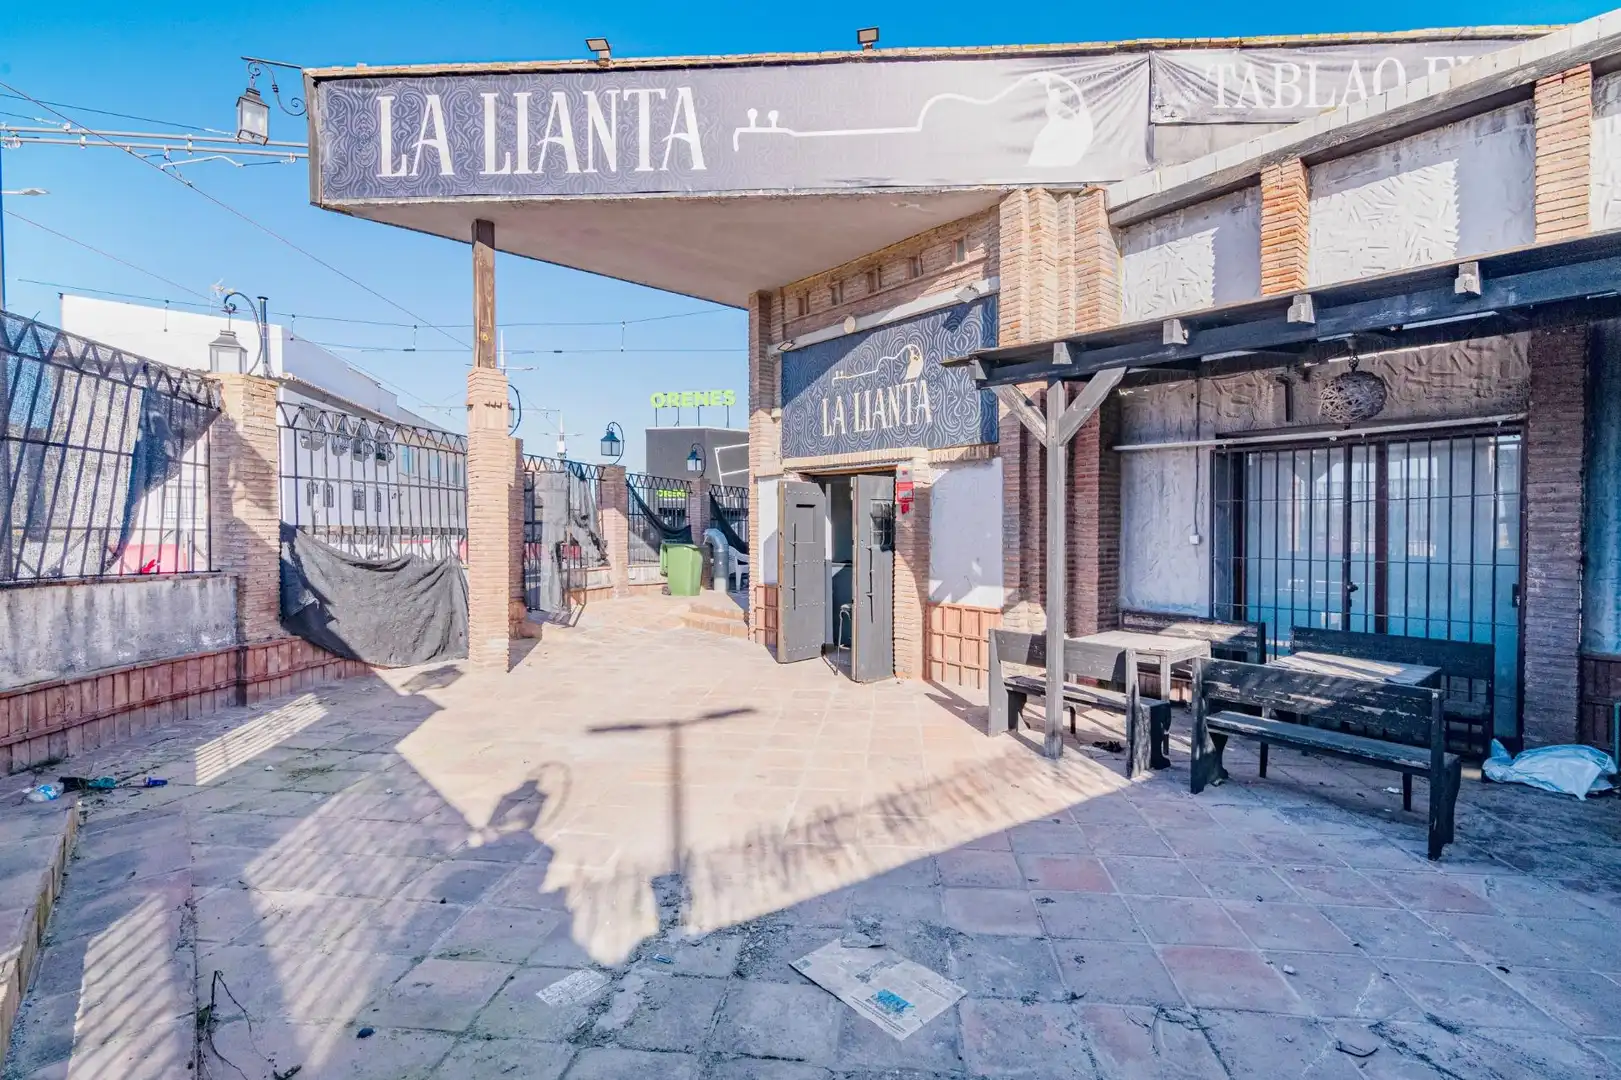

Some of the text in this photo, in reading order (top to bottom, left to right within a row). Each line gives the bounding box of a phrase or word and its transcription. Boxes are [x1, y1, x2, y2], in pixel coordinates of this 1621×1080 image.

[1205, 57, 1406, 109] TABLAO
[376, 94, 455, 178] LA
[650, 389, 736, 409] ORENES
[822, 395, 846, 437] LA
